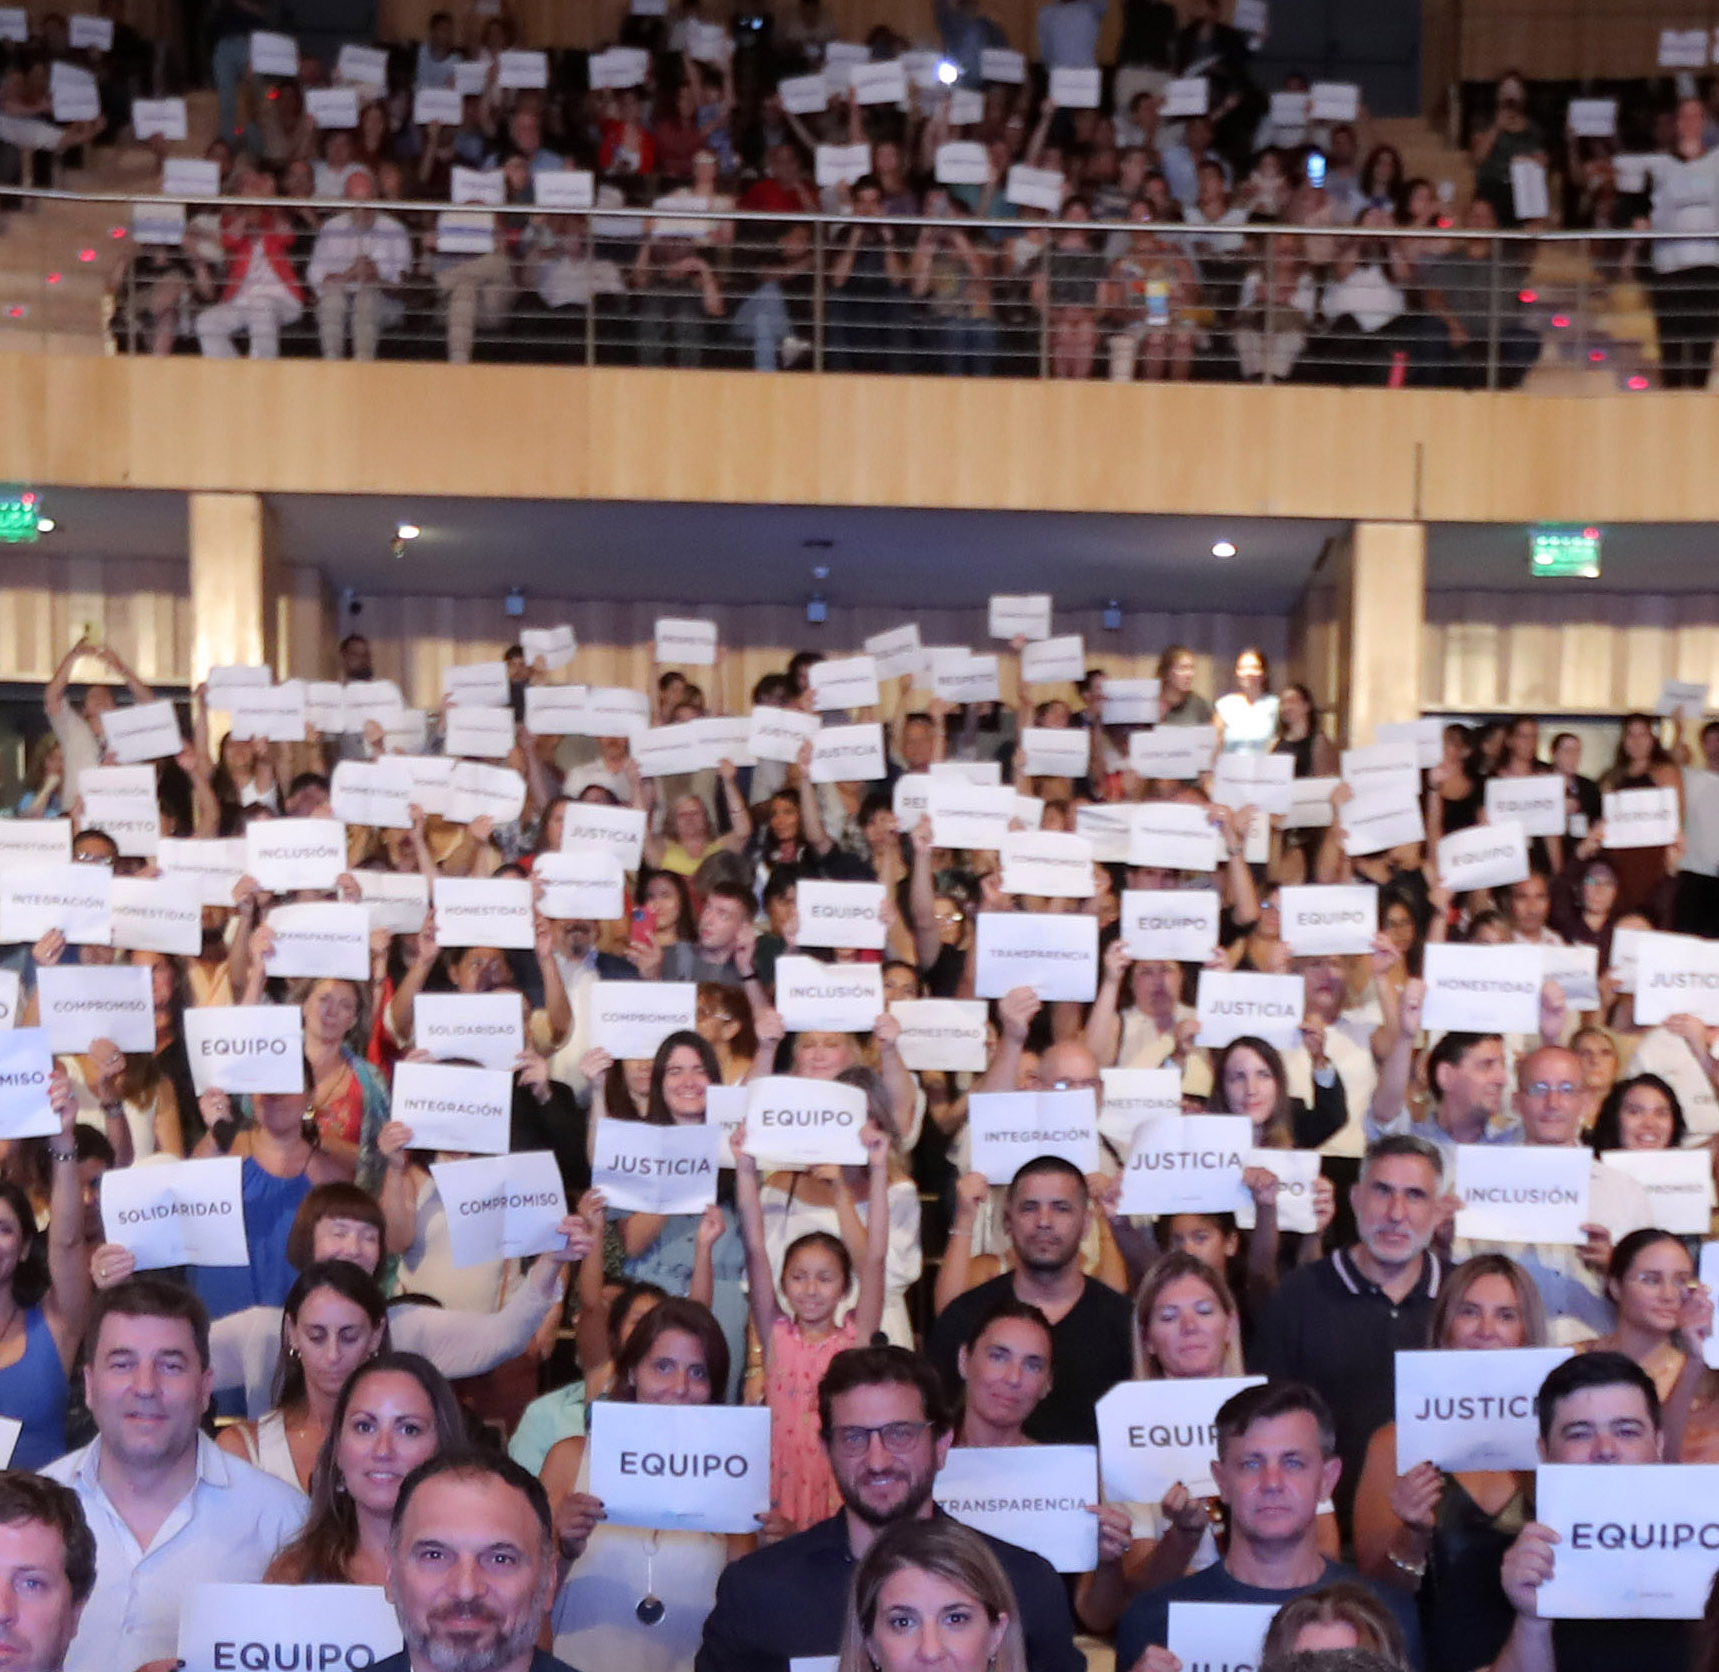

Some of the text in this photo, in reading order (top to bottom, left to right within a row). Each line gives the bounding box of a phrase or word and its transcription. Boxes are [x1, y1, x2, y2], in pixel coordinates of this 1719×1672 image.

[814, 744, 878, 760] JUSTICIA
[1496, 799, 1554, 813] EQUIPO
[568, 825, 638, 843] JUSTICIA
[257, 844, 340, 861] INCLUSIÓN
[1450, 844, 1515, 867] EQUIPO
[11, 892, 106, 909] INTEGRACIÓN
[444, 904, 528, 918] HONESTIDAD
[809, 905, 876, 921] EQUIPO
[1296, 910, 1365, 927] EQUIPO
[1137, 916, 1207, 931] EQUIPO
[990, 949, 1090, 962] TRANSPARENCIA
[788, 981, 876, 999] INCLUSIÓN
[1436, 977, 1535, 995] HONESTIDAD
[52, 1000, 147, 1014] COMPROMISO
[1208, 1001, 1296, 1018] JUSTICIA
[601, 1011, 689, 1025] COMPROMISO
[427, 1023, 516, 1037] SOLIDARIDAD
[201, 1038, 287, 1057] EQUIPO
[403, 1097, 503, 1118] INTEGRACIÓN
[761, 1109, 854, 1128] EQUIPO
[984, 1127, 1090, 1144] INTEGRACIÓN
[607, 1153, 712, 1176] JUSTICIA
[1131, 1151, 1243, 1171] JUSTICIA
[1465, 1184, 1579, 1206] INCLUSIÓN
[117, 1200, 233, 1226] SOLIDARIDAD
[459, 1192, 559, 1218] COMPROMISO
[1414, 1395, 1540, 1420] JUSTICI
[618, 1452, 748, 1478] EQUIPO
[937, 1497, 1089, 1512] TRANSPARENCIA
[213, 1642, 377, 1672] EQUIPO
